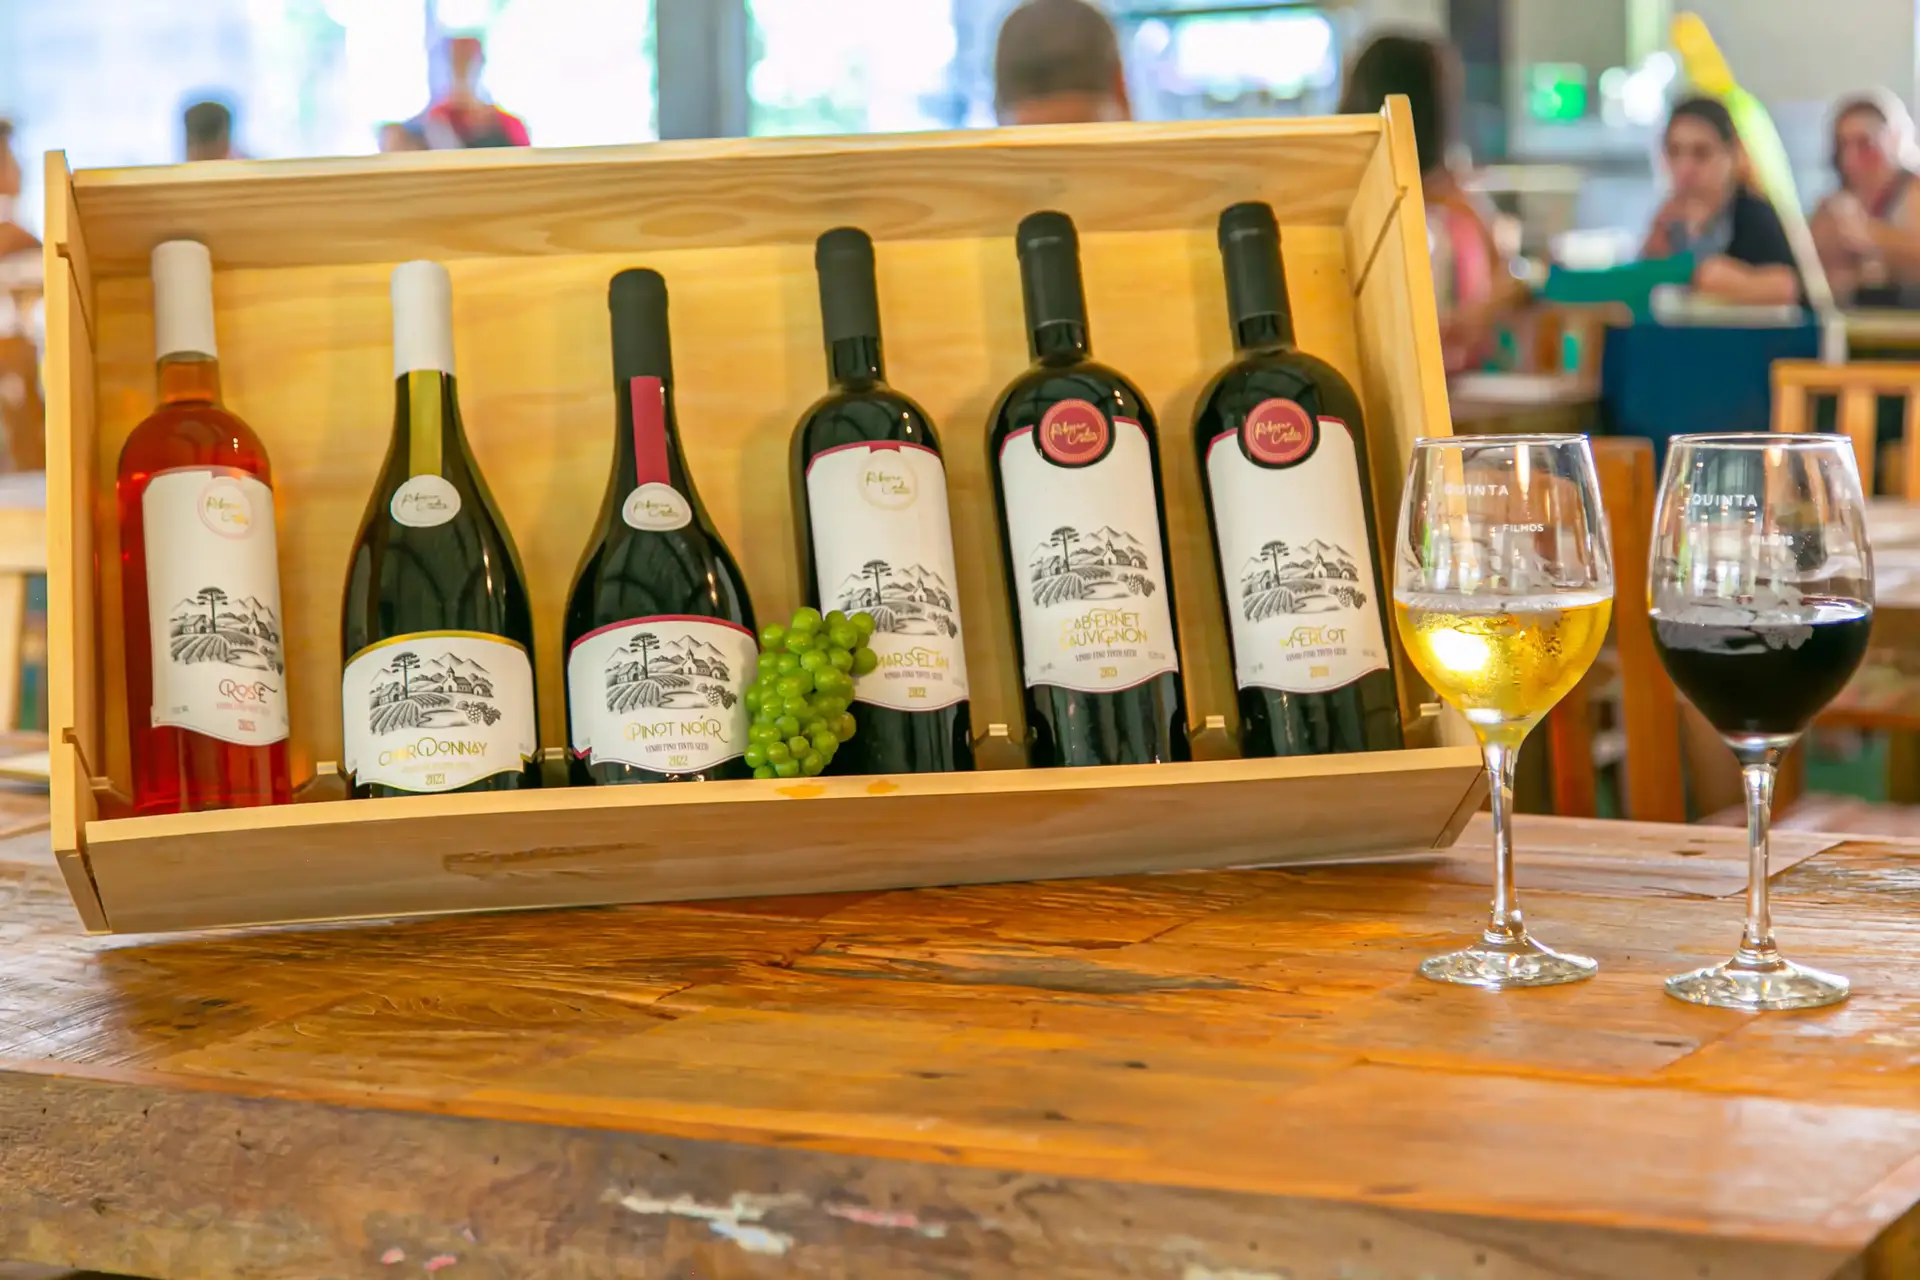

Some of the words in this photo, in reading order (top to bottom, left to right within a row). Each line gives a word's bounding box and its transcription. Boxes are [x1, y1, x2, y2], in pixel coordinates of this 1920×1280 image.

[1444, 484, 1509, 496] QUINTA
[1691, 494, 1758, 507] QUINTA
[1502, 523, 1544, 532] FILHOS
[1060, 607, 1141, 635] CABERNET
[1059, 627, 1148, 652] SAUVIGNON
[1280, 624, 1347, 651] MERLOT
[624, 721, 677, 742] PINOT
[378, 736, 488, 767] CHARDONNAY
